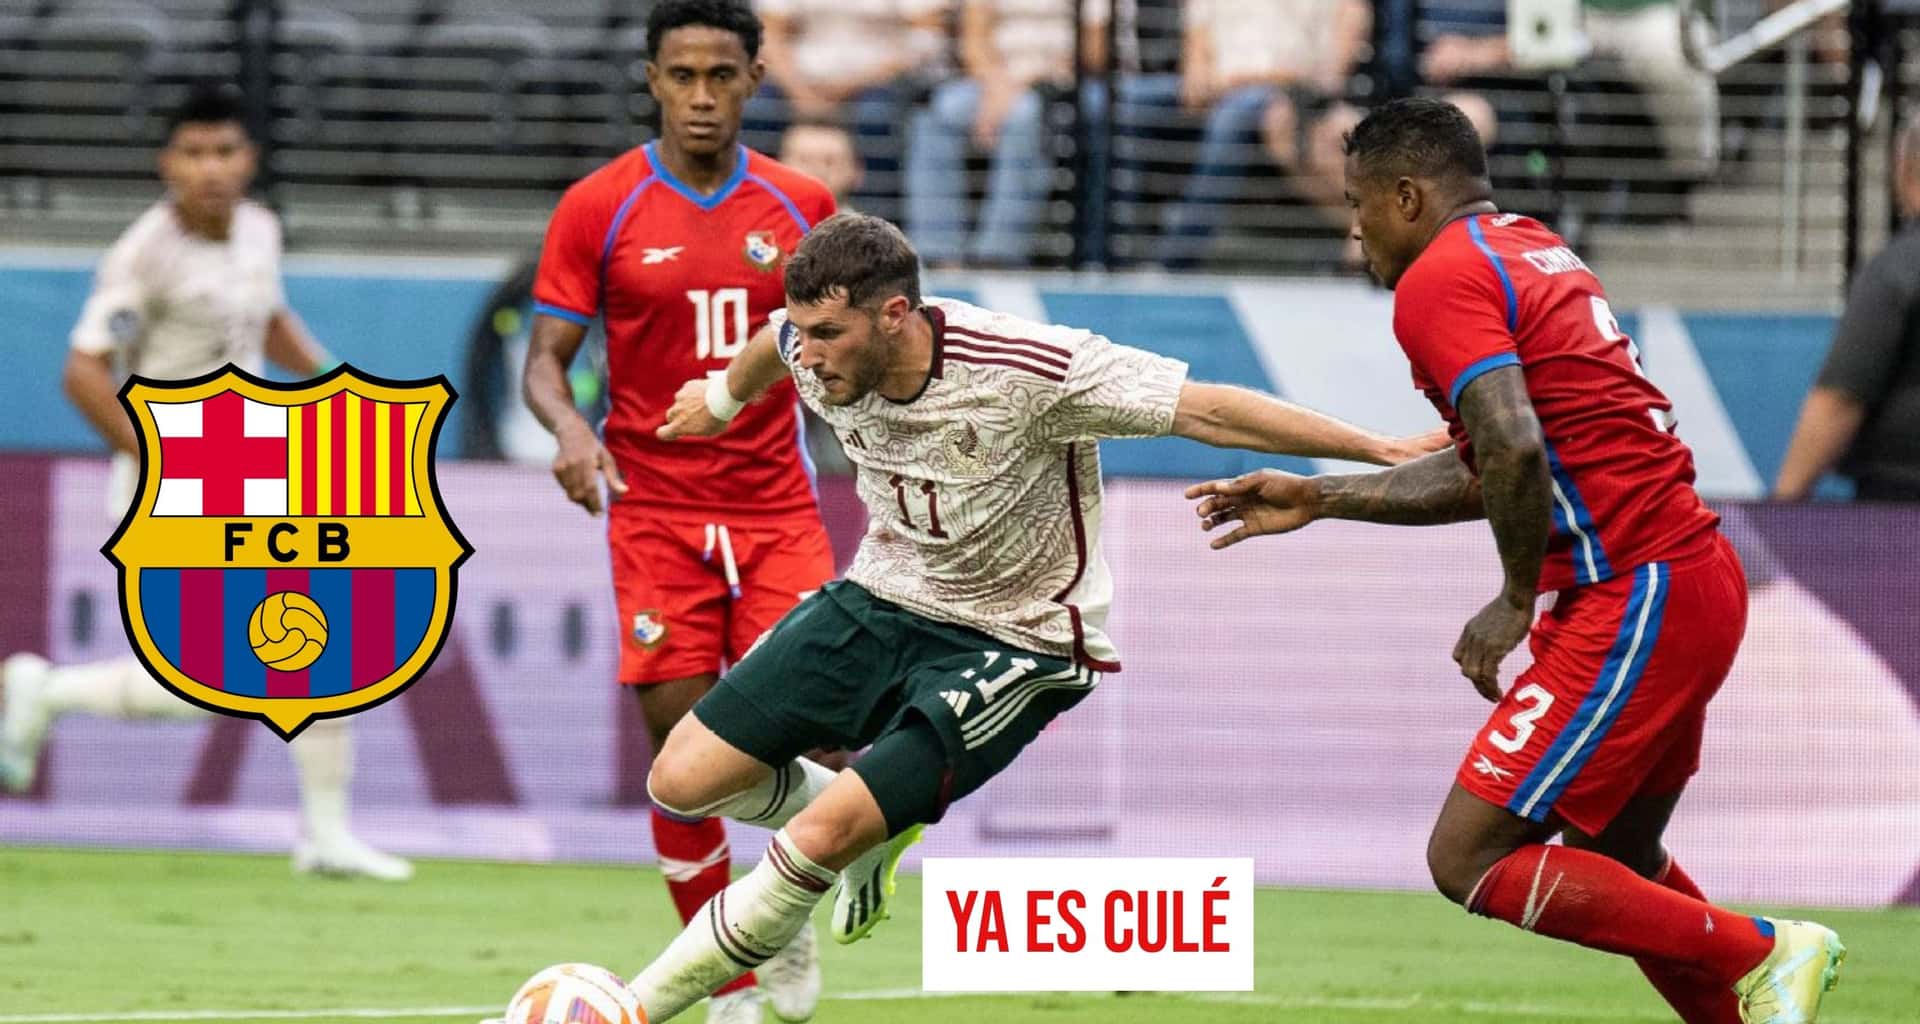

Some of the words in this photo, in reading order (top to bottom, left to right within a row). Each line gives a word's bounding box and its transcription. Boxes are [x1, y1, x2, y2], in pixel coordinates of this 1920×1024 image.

[686, 288, 749, 360] 10
[889, 473, 950, 539] 11
[1488, 683, 1555, 754] 3
